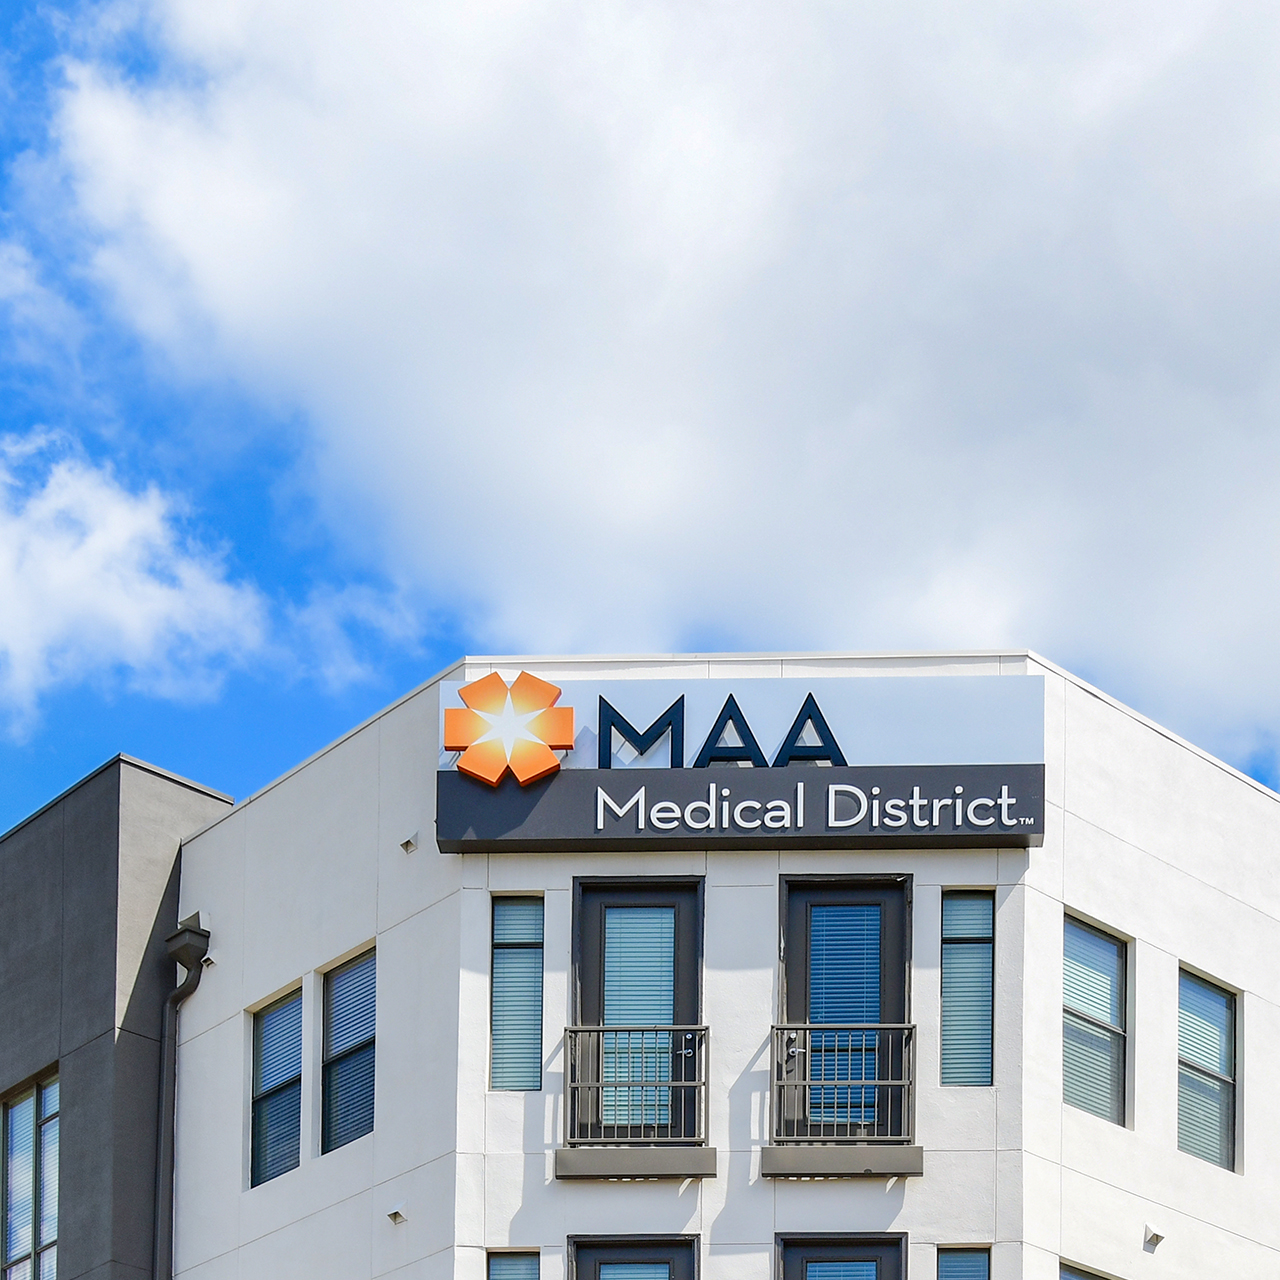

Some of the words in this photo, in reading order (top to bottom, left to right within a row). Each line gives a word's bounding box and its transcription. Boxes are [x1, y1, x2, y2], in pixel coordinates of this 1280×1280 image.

[597, 691, 849, 769] MAA
[596, 781, 805, 830] Medical
[827, 784, 1019, 828] District
